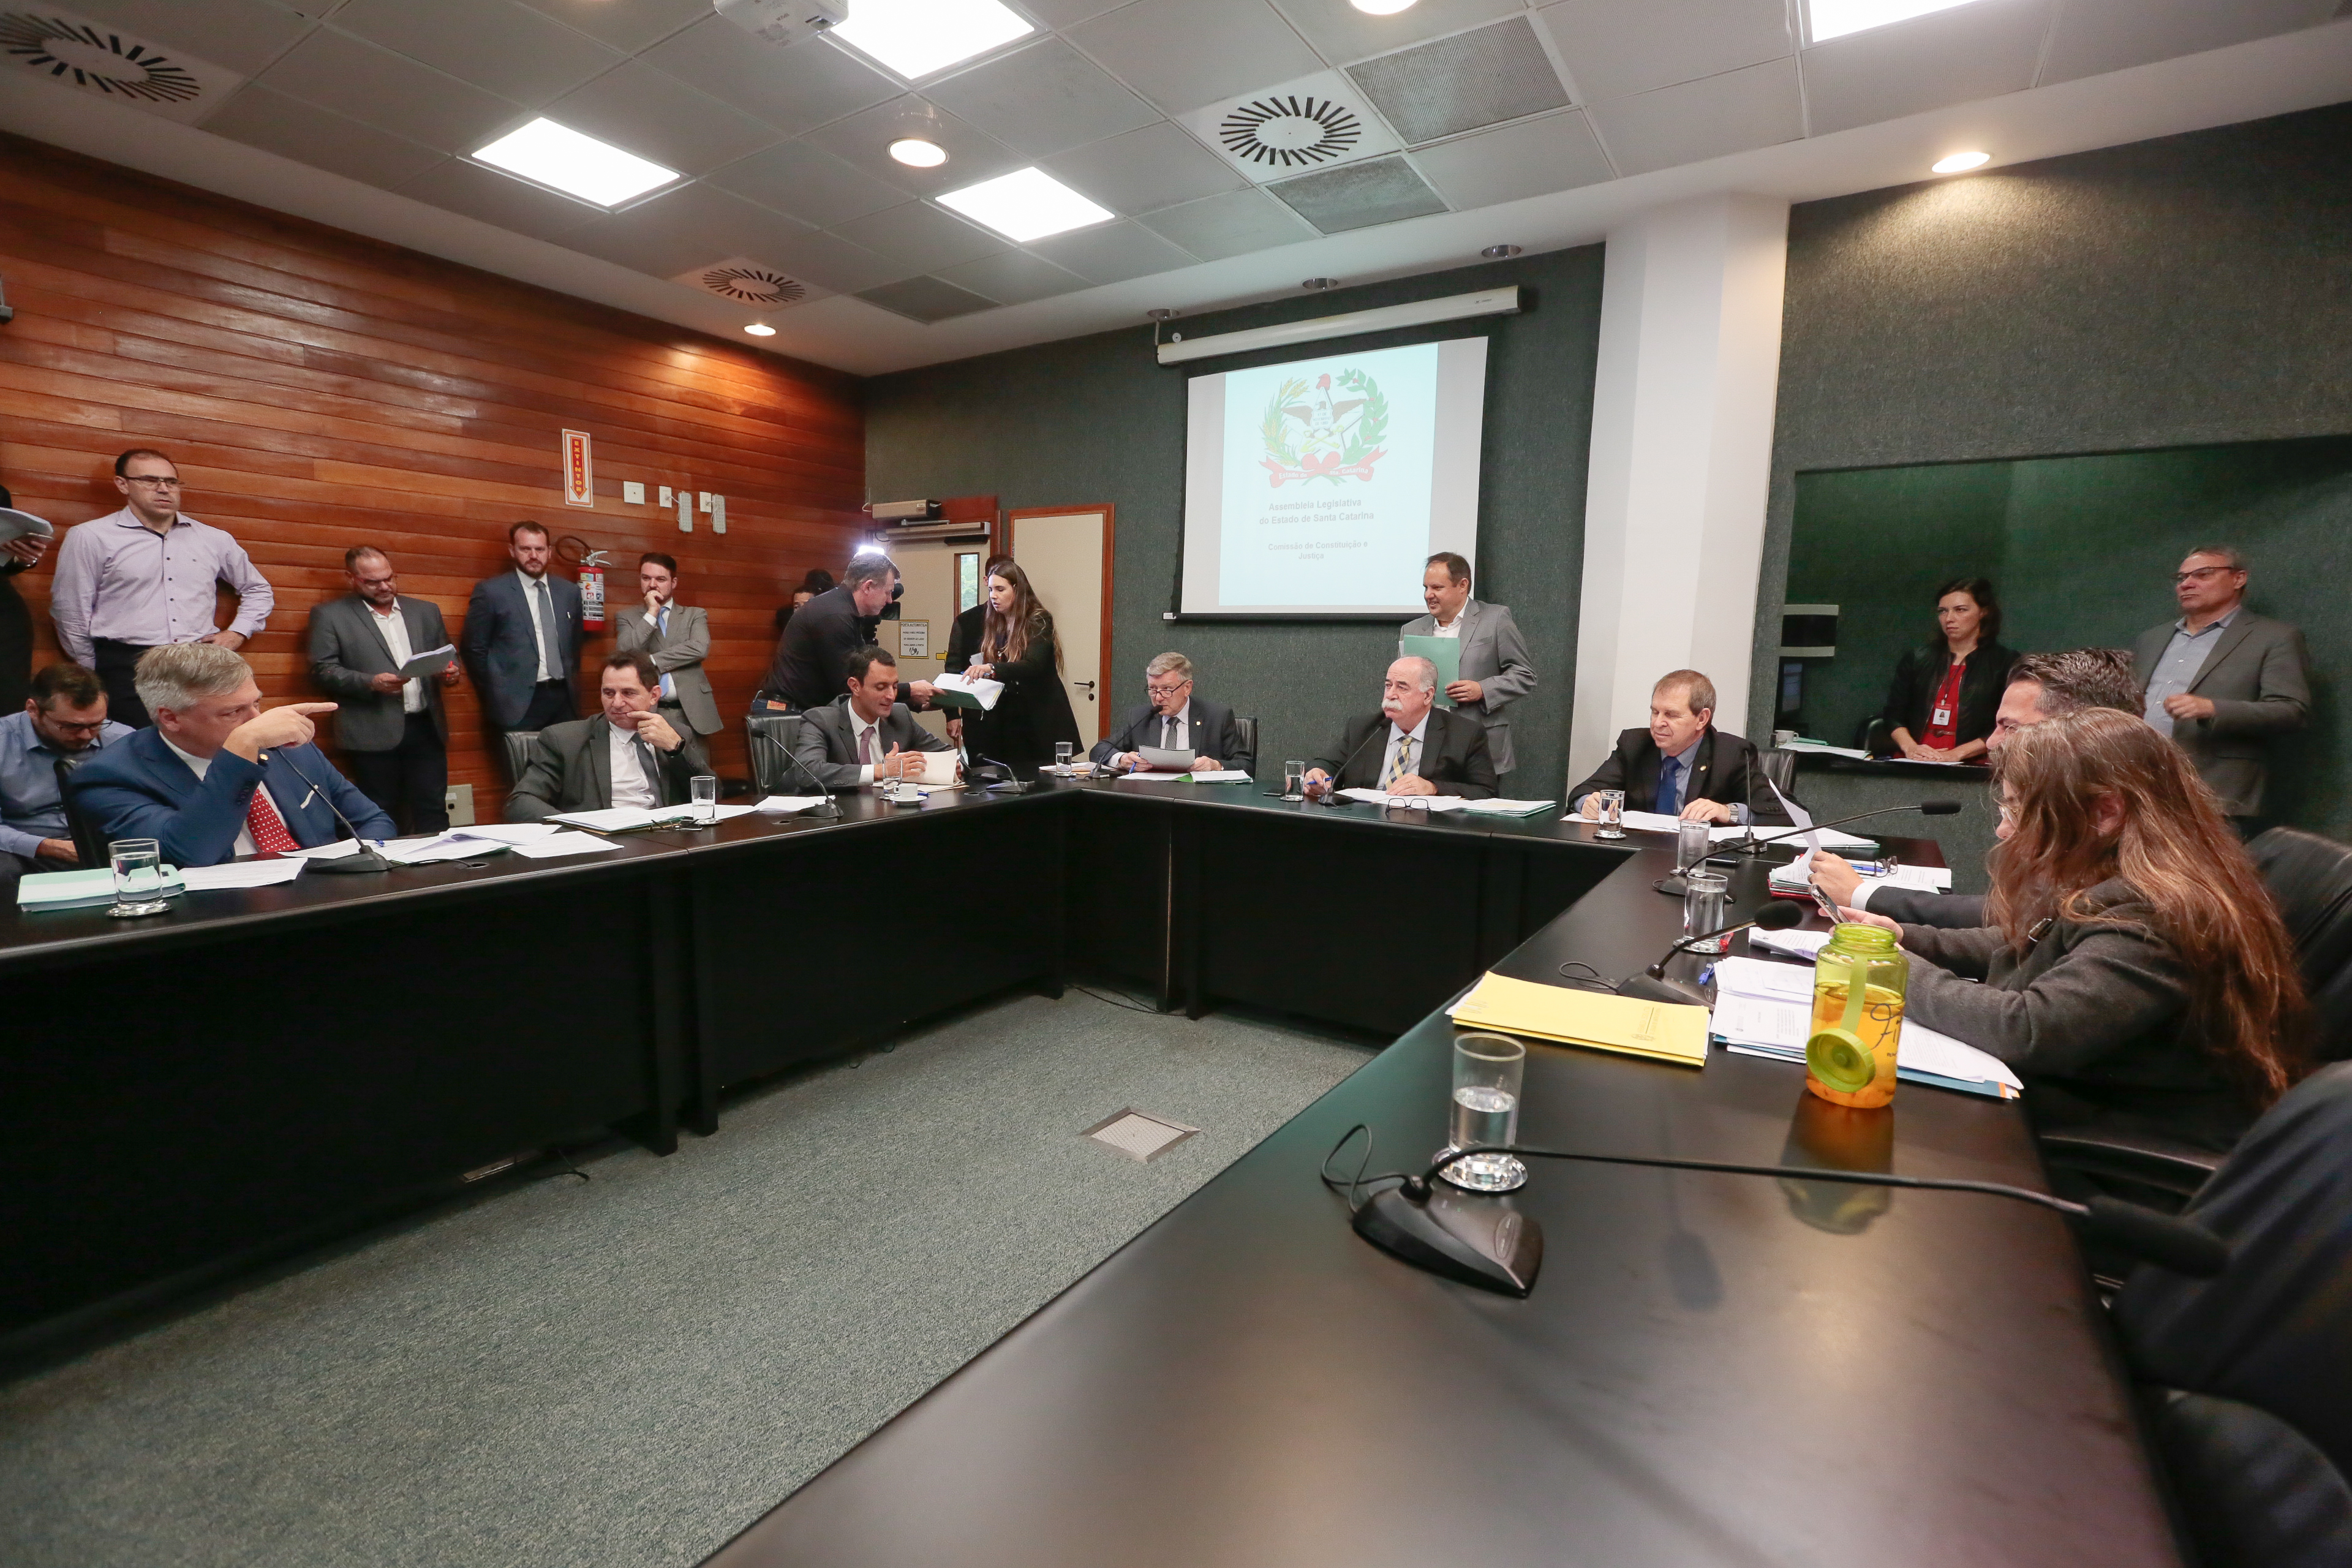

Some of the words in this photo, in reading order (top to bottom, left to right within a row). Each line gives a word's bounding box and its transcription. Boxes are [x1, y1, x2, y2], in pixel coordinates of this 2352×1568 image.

[574, 440, 582, 492] EXTINTOR
[1268, 501, 1314, 511] Assembleia
[1317, 499, 1362, 510] Legislativa
[1272, 516, 1299, 524] Estado
[1339, 511, 1374, 521] Catarina
[1316, 540, 1362, 549] Constituição
